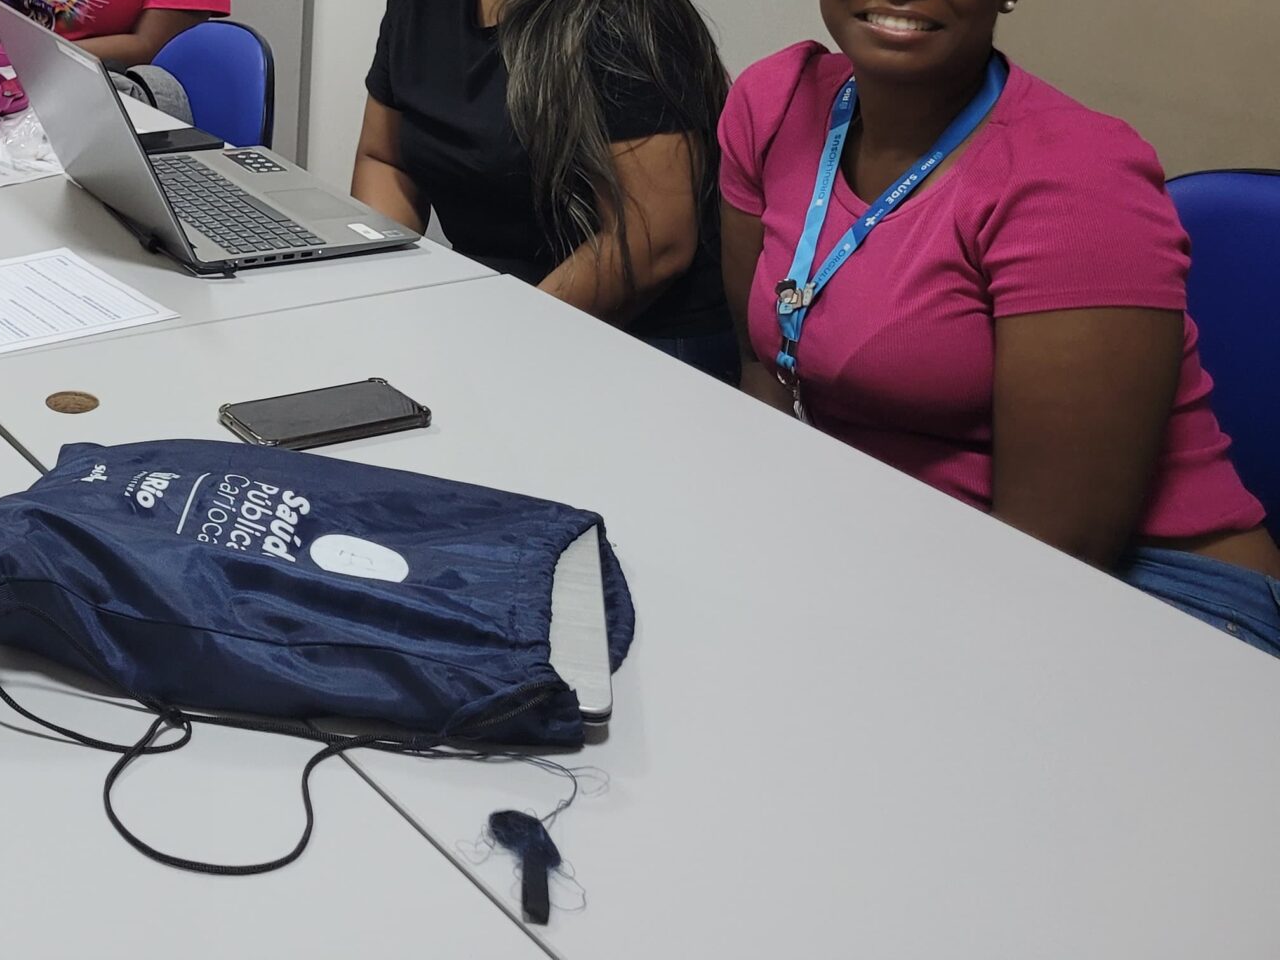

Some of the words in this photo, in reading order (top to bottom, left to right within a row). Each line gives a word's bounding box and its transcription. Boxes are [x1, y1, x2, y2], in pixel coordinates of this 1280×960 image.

[920, 157, 936, 171] Rio
[885, 173, 918, 205] SAÚDE
[261, 490, 311, 563] Saúd
